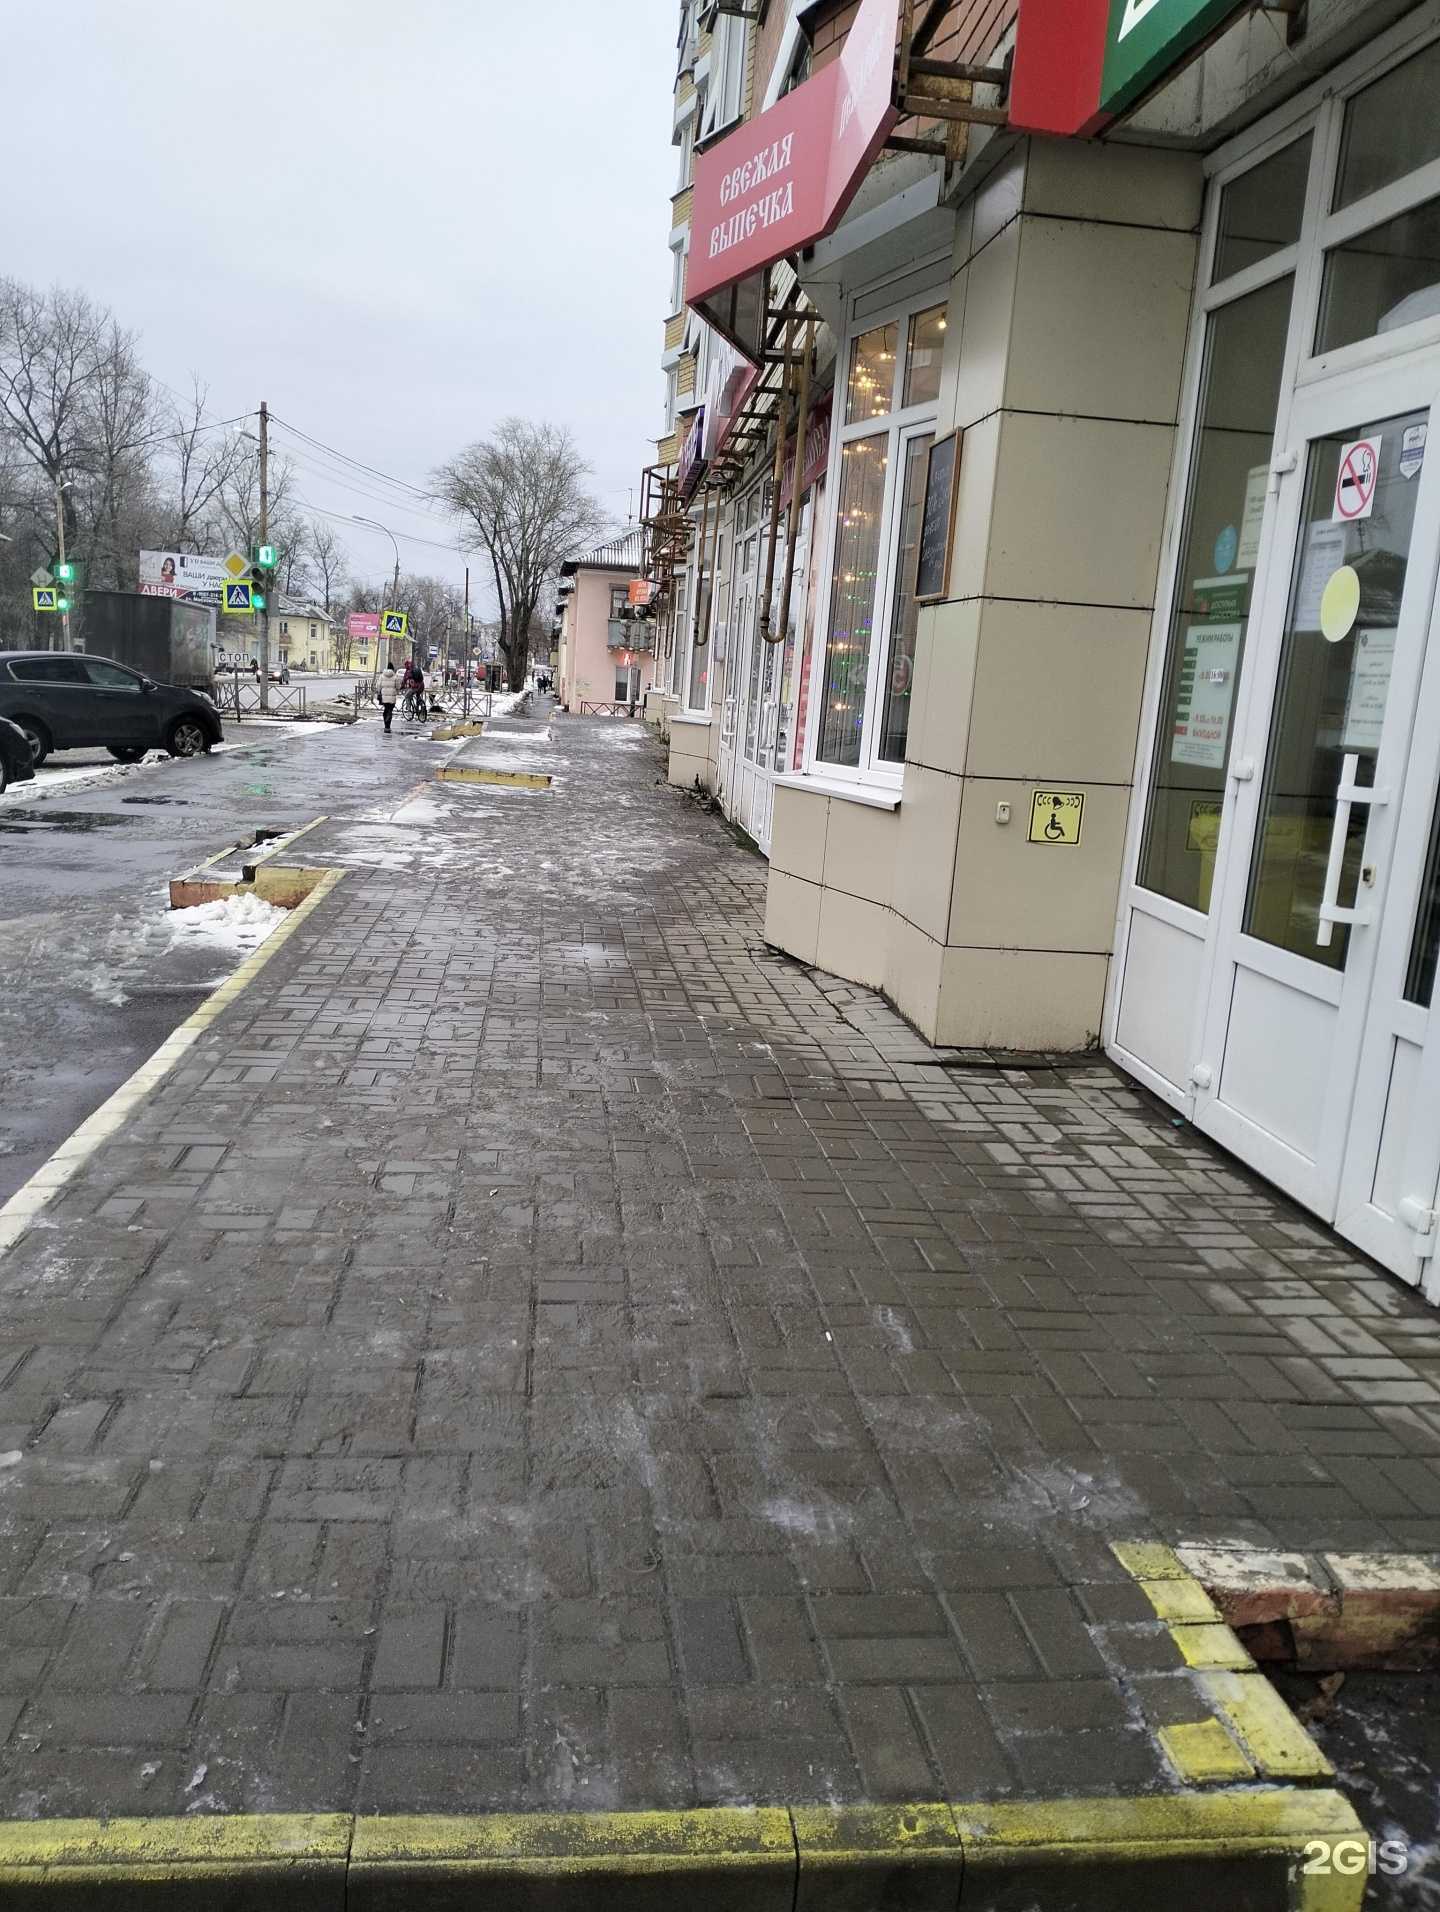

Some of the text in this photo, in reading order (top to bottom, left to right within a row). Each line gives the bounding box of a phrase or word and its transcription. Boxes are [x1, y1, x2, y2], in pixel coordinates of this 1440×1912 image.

[720, 132, 794, 207] СВЕЖАЯ
[709, 181, 794, 258] ВЫПЕЧКА
[141, 584, 178, 598] ДВЕРИ
[219, 653, 249, 662] СТОП
